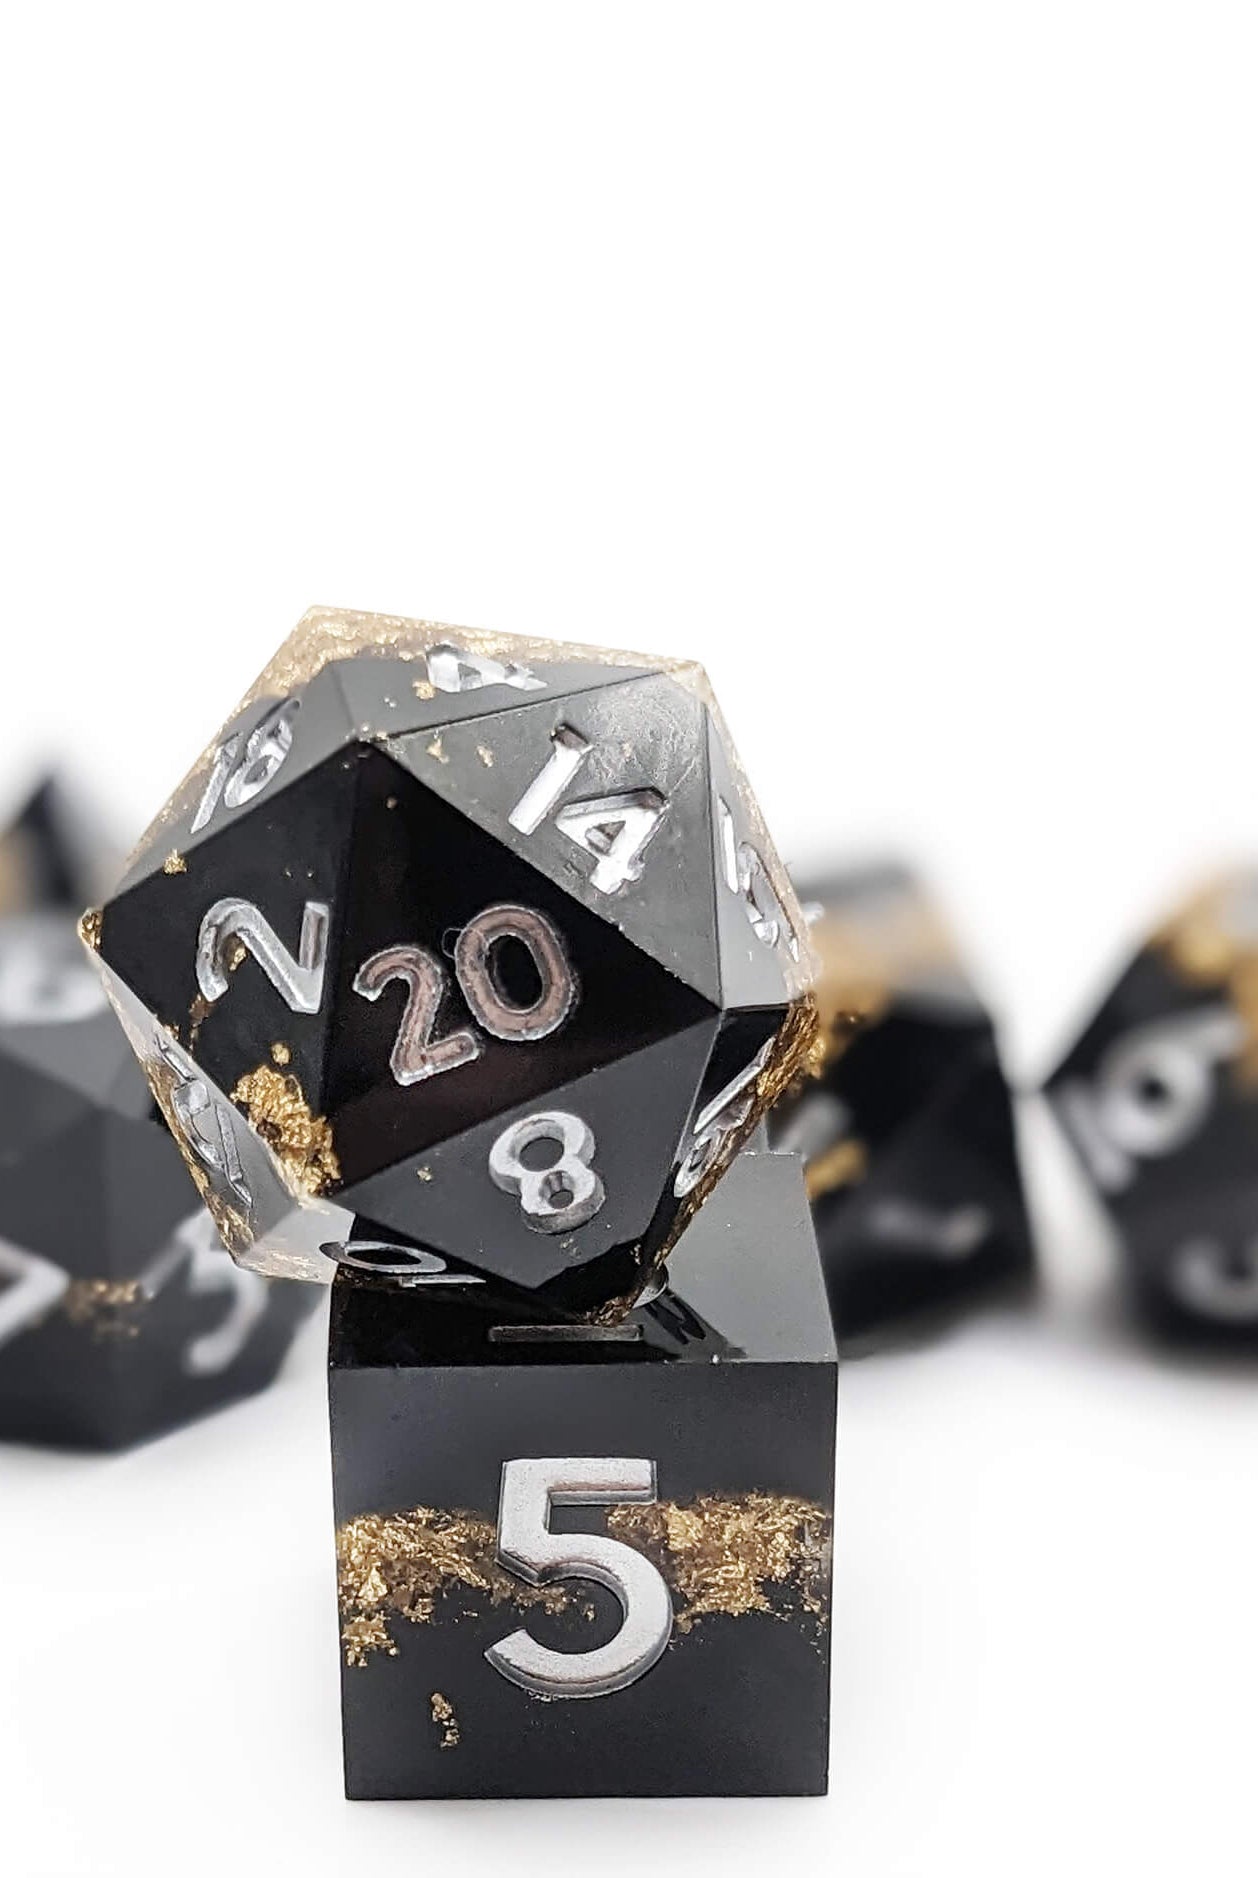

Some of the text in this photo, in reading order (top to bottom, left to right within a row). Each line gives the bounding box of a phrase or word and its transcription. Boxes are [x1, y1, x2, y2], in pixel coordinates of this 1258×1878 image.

[425, 643, 548, 692] 4
[508, 723, 669, 895] 14
[196, 897, 329, 1014] 2
[353, 903, 573, 1087] 20
[489, 1111, 605, 1235] 8
[484, 1457, 674, 1699] 5
